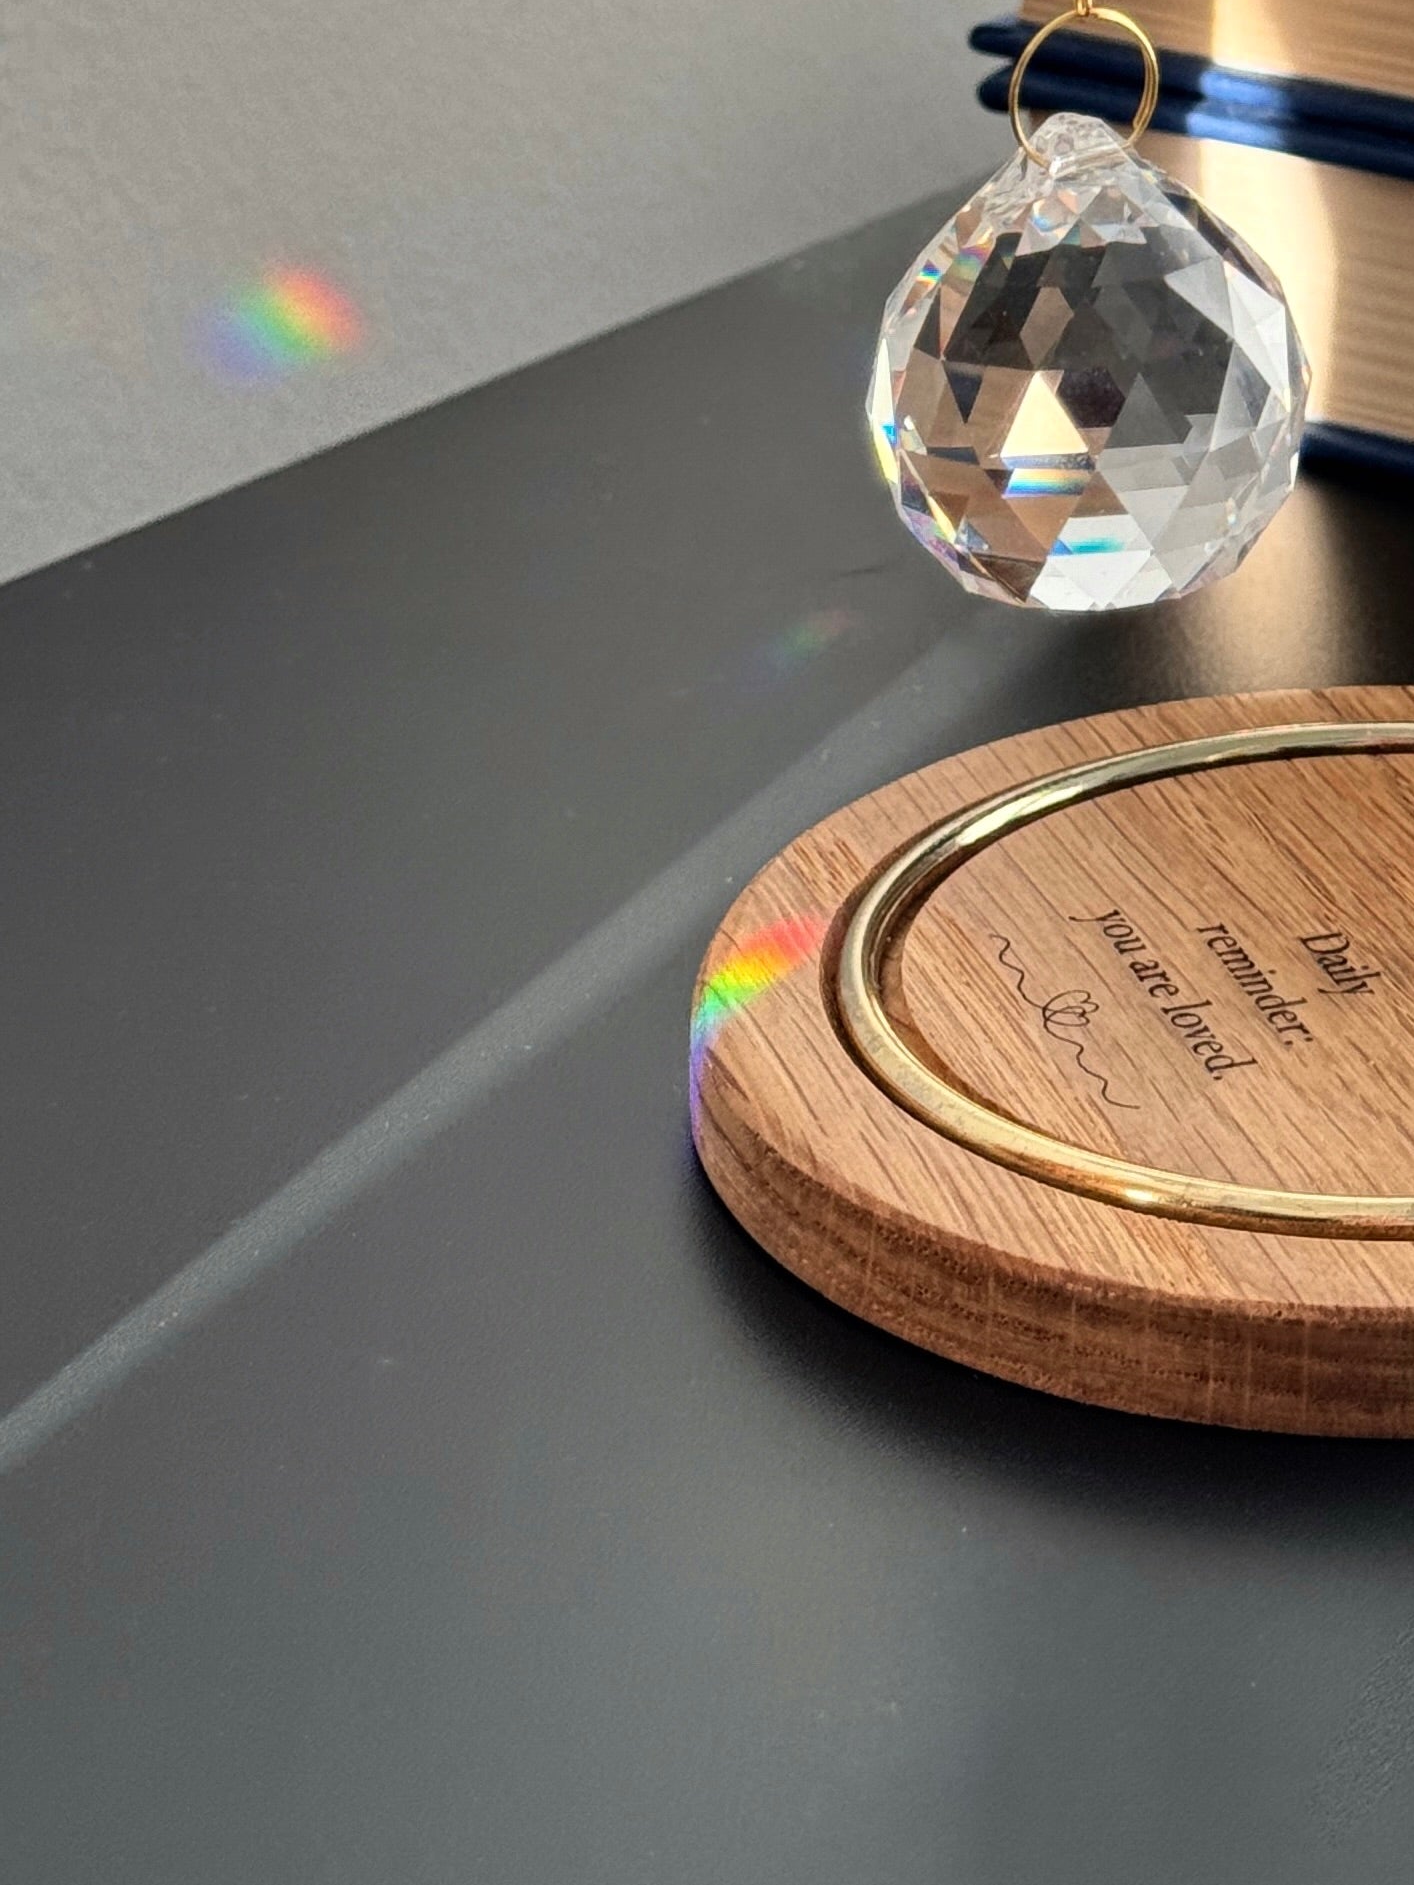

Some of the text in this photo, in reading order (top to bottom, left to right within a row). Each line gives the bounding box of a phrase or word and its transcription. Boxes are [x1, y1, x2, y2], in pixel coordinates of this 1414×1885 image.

[1068, 908, 1258, 1082] you are loved.
[1196, 921, 1315, 1050] reminder:
[1300, 929, 1381, 996] Daily
